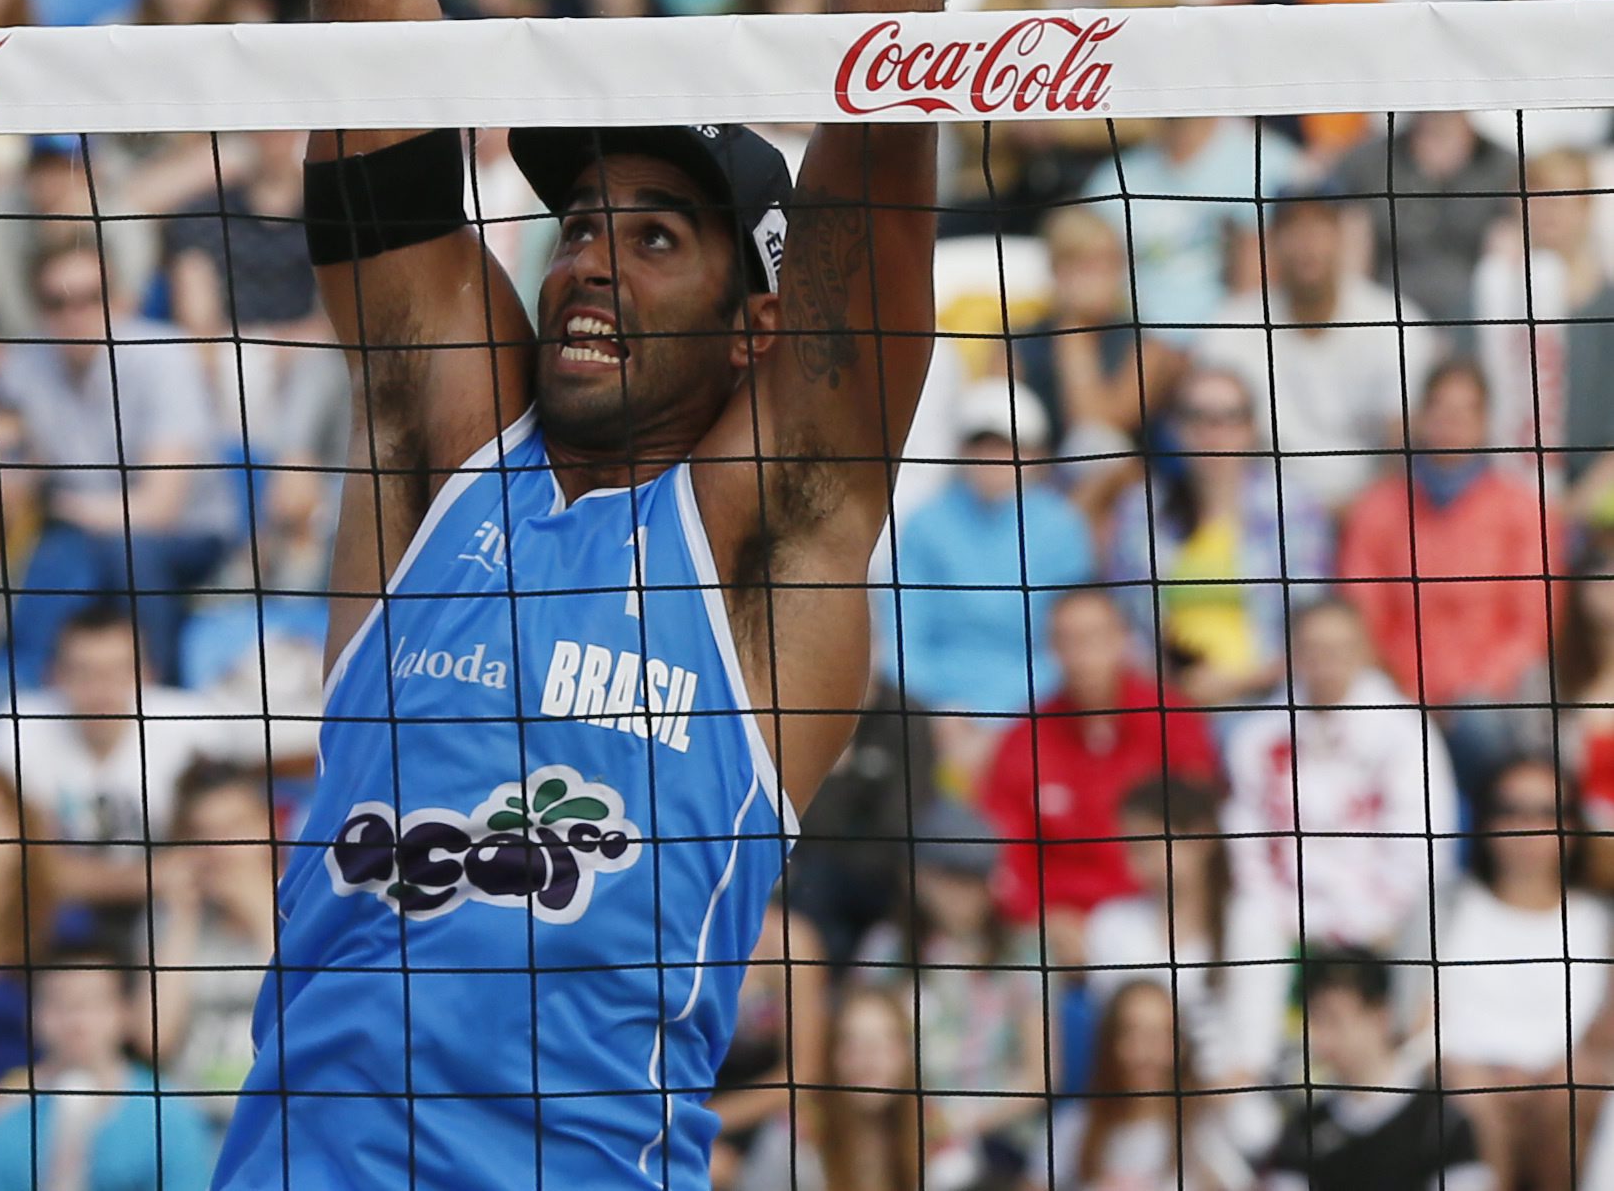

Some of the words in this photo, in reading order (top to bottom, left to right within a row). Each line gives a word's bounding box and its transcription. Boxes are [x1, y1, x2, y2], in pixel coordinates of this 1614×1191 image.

[834, 16, 1131, 116] Coca-Cola
[622, 525, 649, 621] 1
[539, 639, 699, 754] BRASIL
